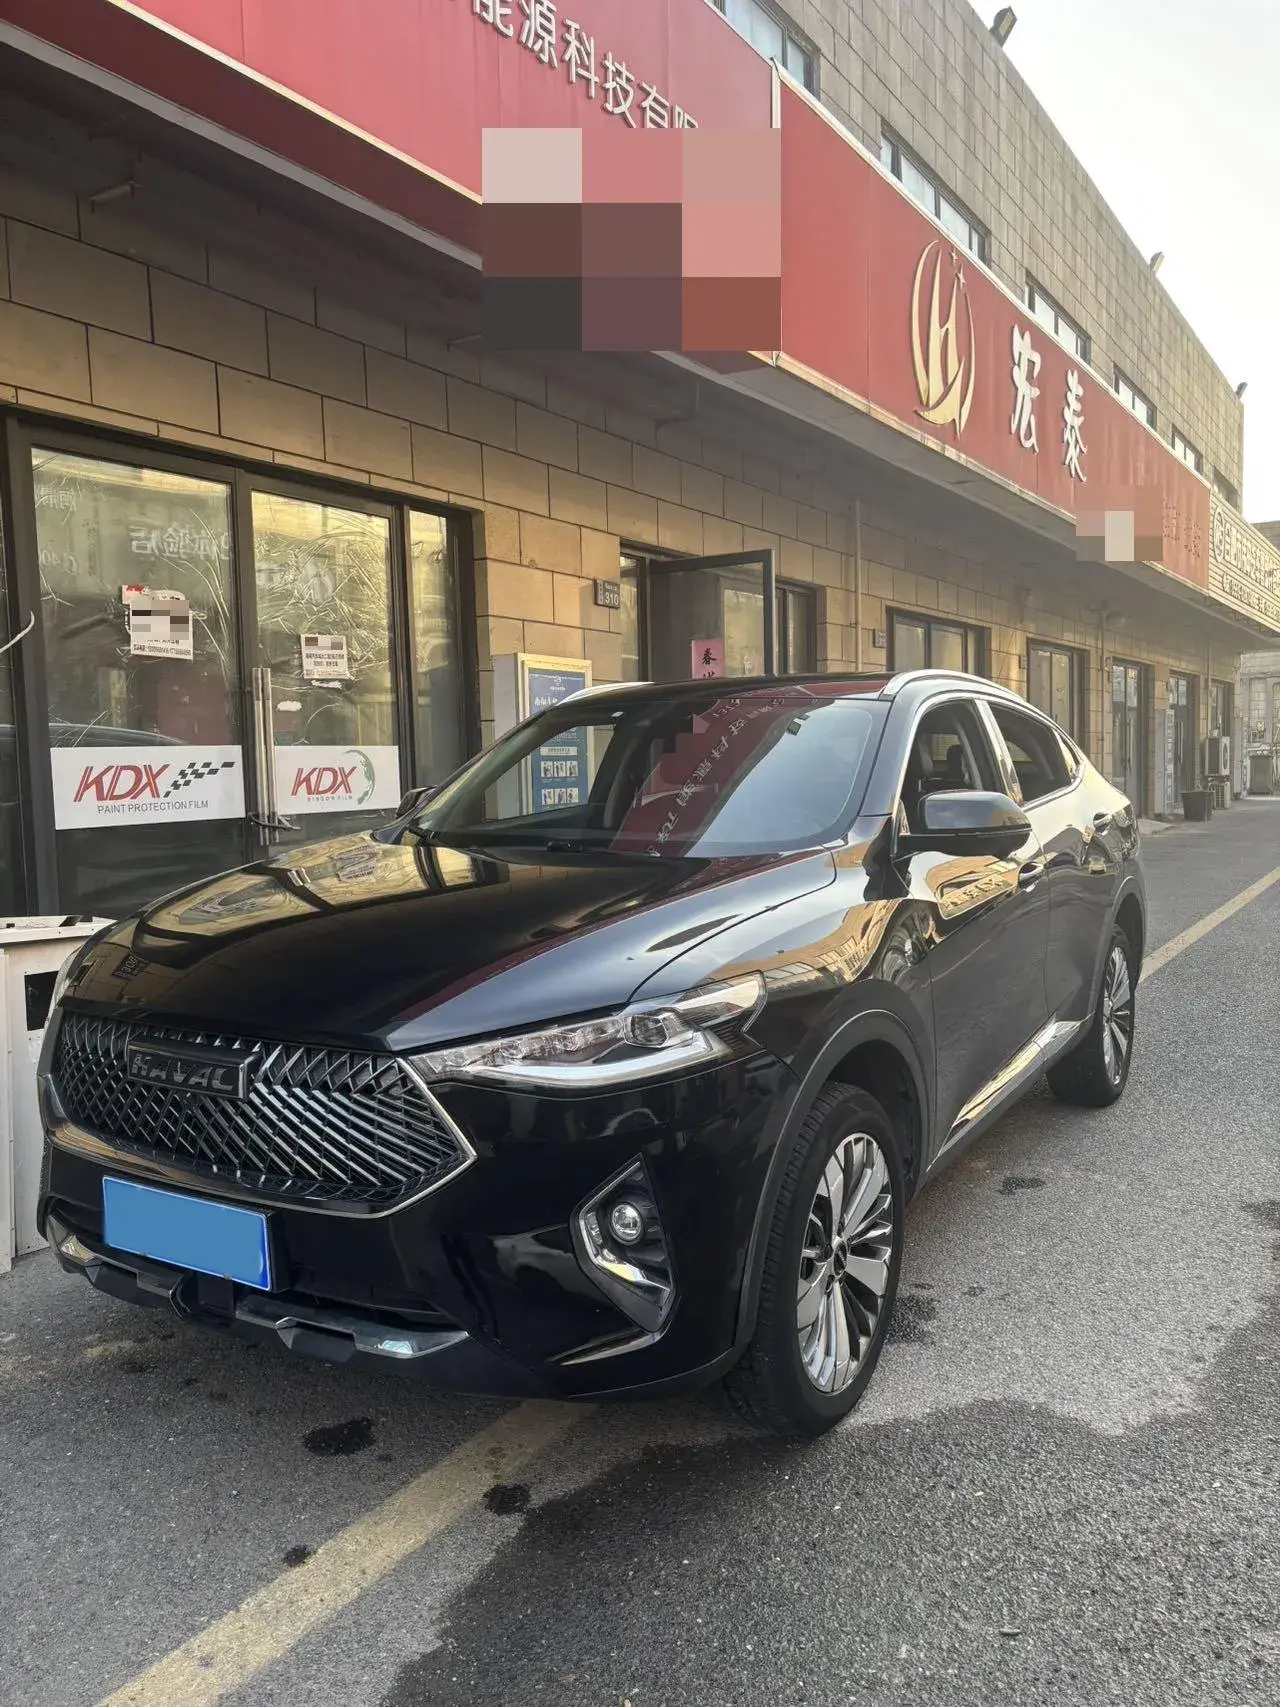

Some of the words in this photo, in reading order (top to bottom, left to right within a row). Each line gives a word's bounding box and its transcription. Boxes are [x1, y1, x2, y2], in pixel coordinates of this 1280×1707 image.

[1011, 324, 1087, 483] 宏泰
[605, 592, 619, 606] 310
[73, 763, 170, 802] KDX
[291, 766, 357, 796] KDX
[98, 804, 125, 814] PAINT
[128, 801, 189, 812] PROTECTION
[189, 800, 209, 809] FILM
